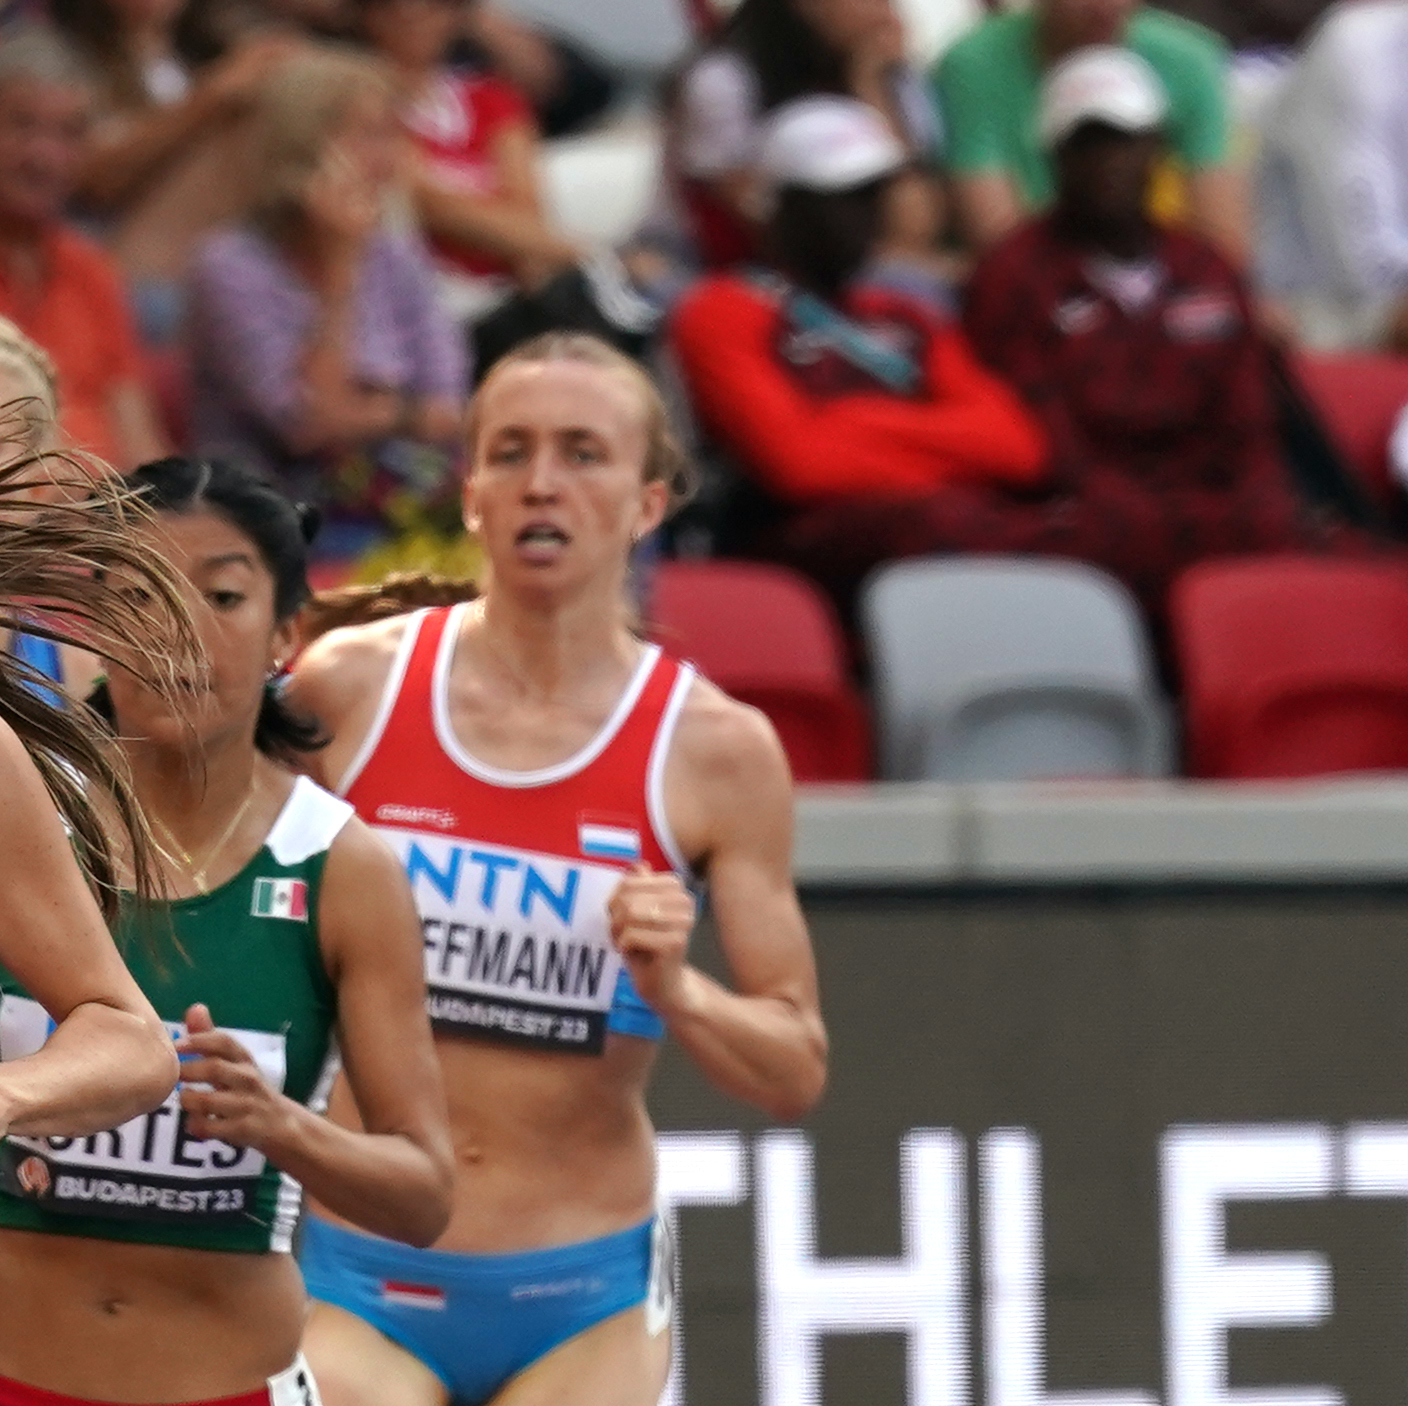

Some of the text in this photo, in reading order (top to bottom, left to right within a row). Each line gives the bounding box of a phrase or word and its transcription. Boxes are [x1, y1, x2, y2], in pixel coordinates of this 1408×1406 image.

[406, 840, 580, 927] NTN
[54, 1175, 245, 1212] BUDAPEST 23
